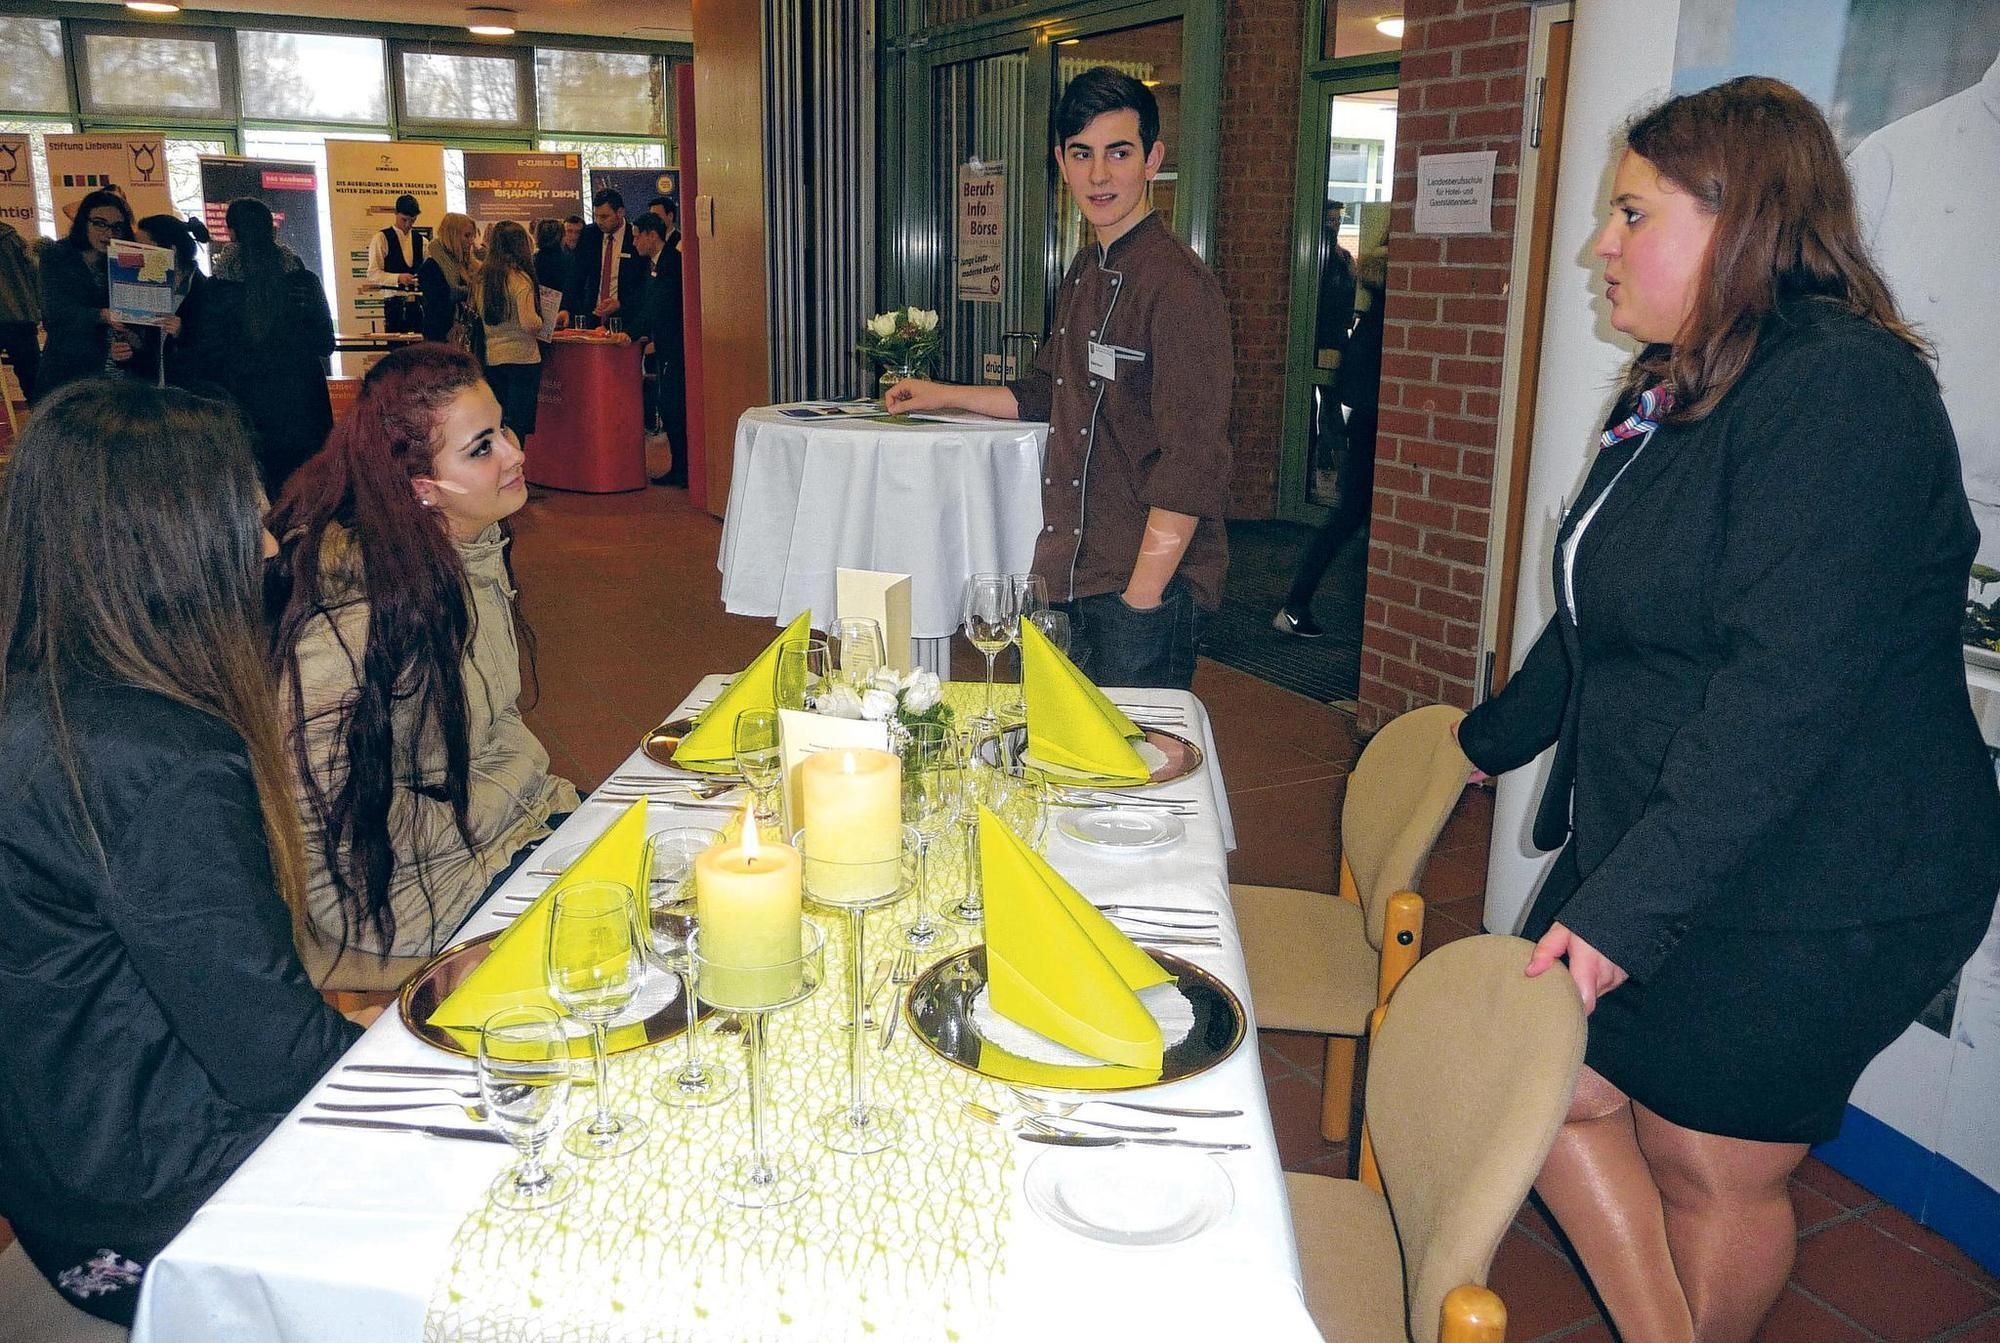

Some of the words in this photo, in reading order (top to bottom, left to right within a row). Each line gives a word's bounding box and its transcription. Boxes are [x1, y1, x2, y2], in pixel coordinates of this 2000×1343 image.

[50, 142, 83, 151] Stiftung
[85, 142, 122, 150] Liebenau
[468, 180, 502, 188] DEINE
[963, 181, 995, 197] Berufs
[494, 189, 550, 199] BRAUCHT
[551, 190, 580, 199] DICH
[1462, 187, 1474, 195] und
[967, 201, 987, 217] Info
[970, 220, 998, 235] Börse
[985, 361, 1014, 375] drücen
